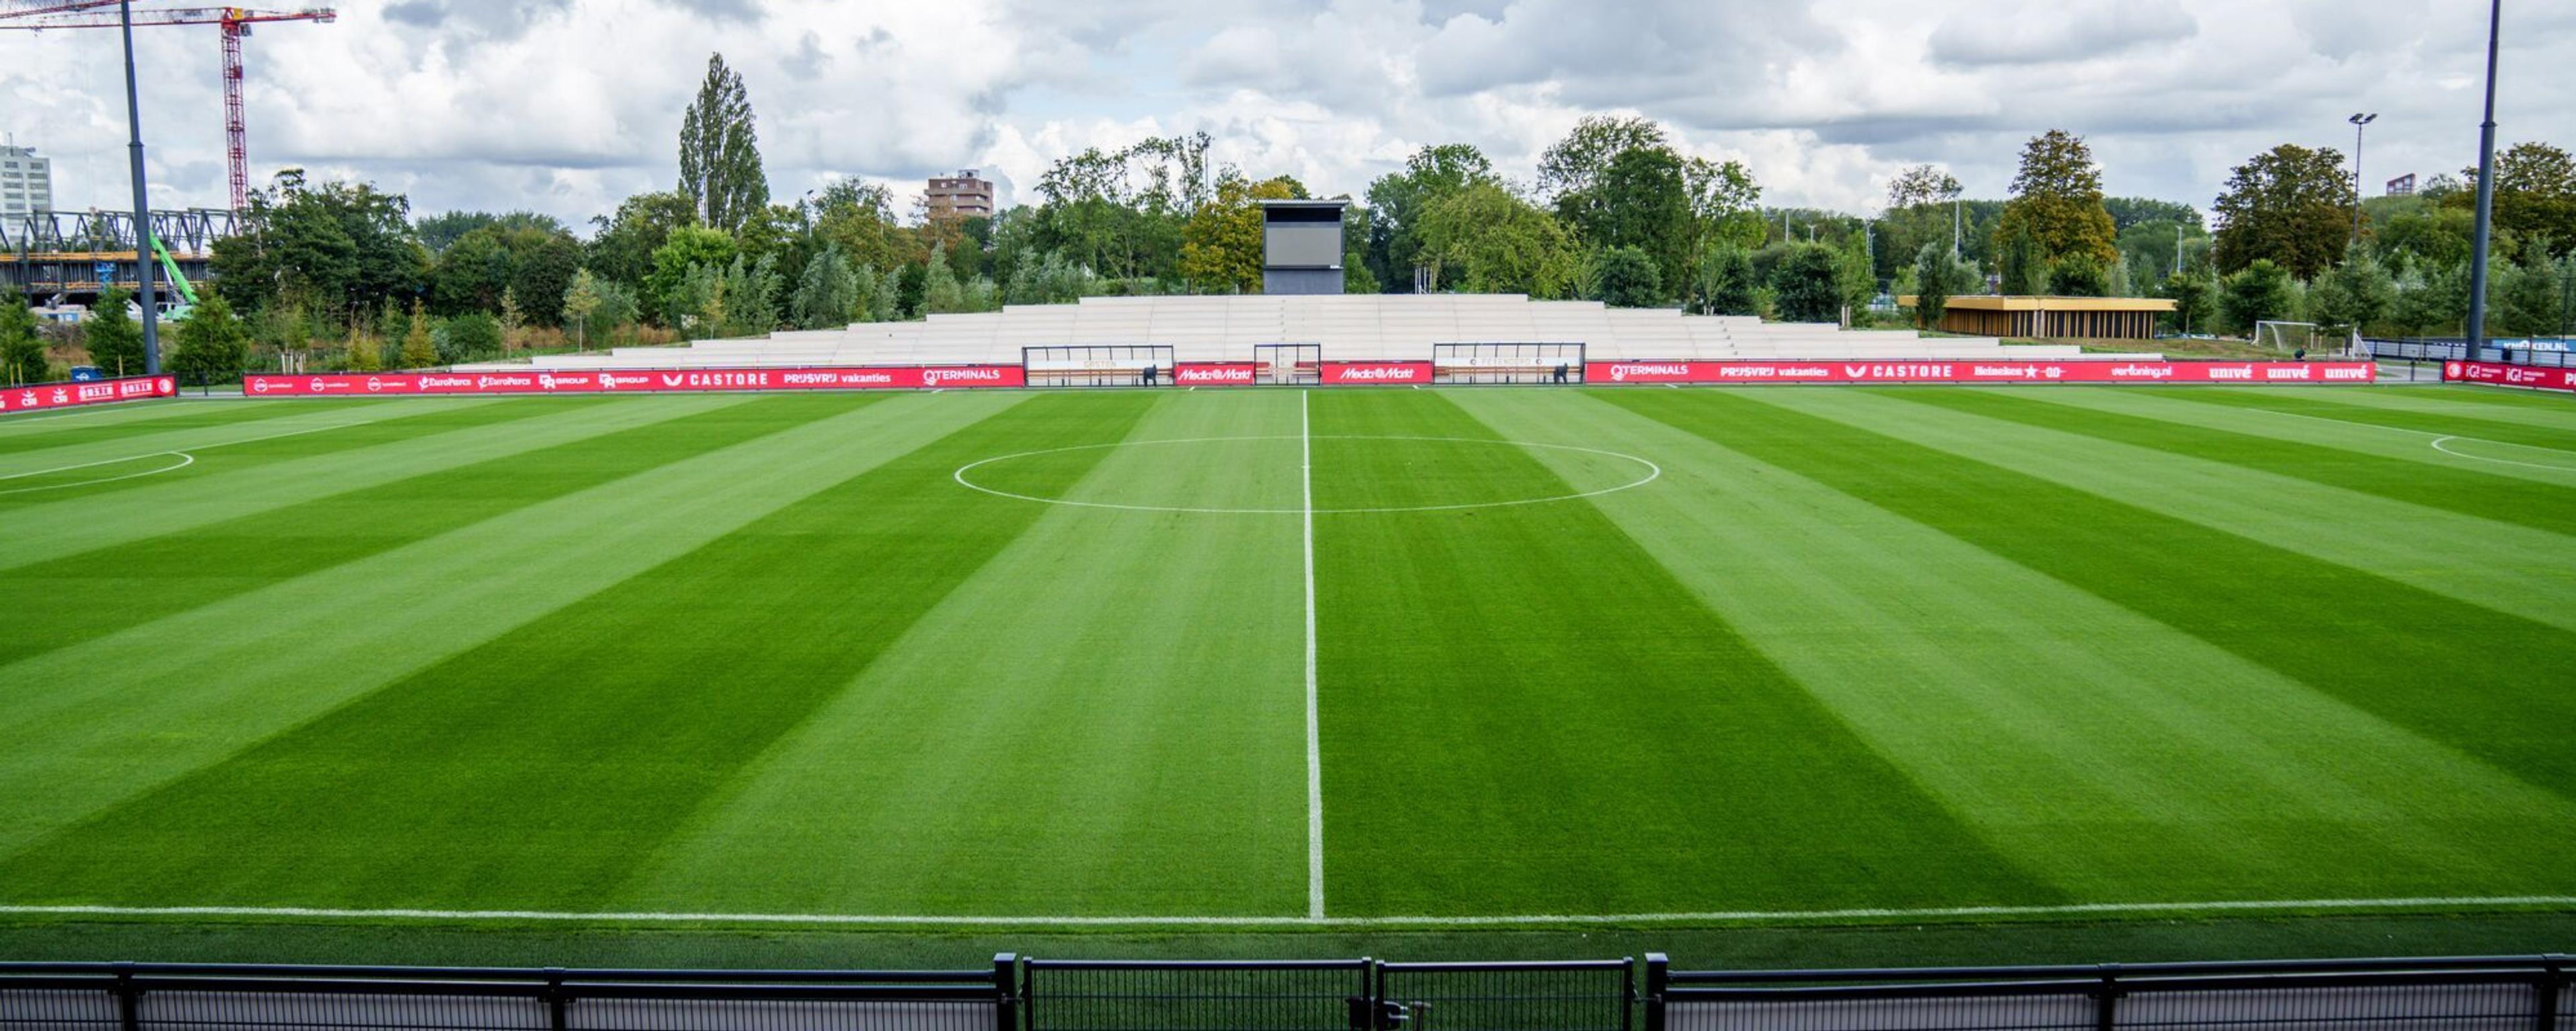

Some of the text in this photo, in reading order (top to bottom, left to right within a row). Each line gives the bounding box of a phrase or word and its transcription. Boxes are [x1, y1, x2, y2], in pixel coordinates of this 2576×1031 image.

[841, 373, 891, 383] vakanties
[924, 369, 1000, 385] QTERMINALS
[1610, 364, 1688, 381] QTERMINALS
[1778, 366, 1829, 377] vakanties
[1873, 365, 1952, 377] CASTORE
[1974, 366, 2023, 376] Heineken
[2111, 363, 2172, 379] vertoning.nl
[2209, 364, 2252, 379] univé
[2267, 364, 2310, 379] univé
[2324, 364, 2368, 379] univé
[690, 373, 767, 385] CASTORE
